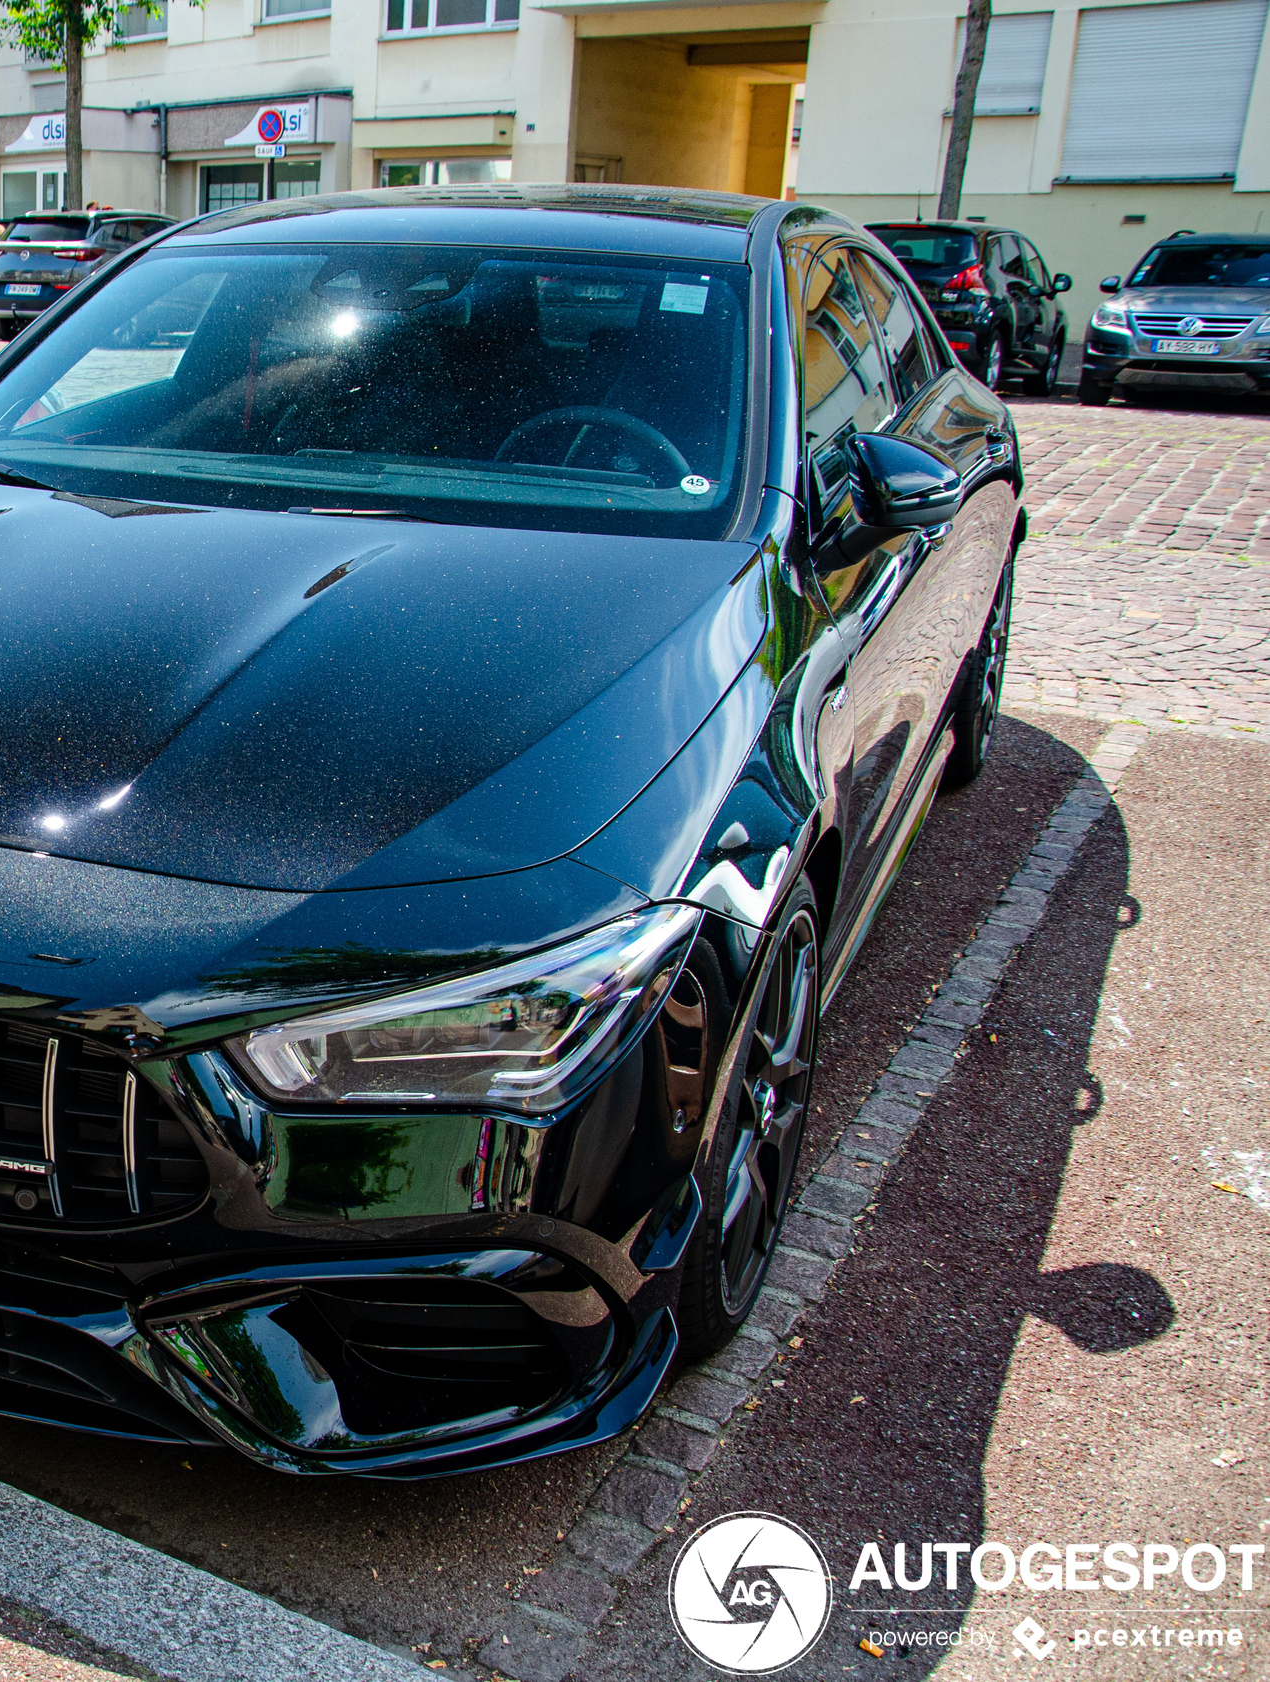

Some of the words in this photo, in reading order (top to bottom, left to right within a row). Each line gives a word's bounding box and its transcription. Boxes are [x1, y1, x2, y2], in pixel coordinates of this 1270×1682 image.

[281, 108, 302, 131] lsi
[42, 118, 65, 140] dlsi
[257, 147, 274, 155] SAUF
[686, 477, 705, 487] 45
